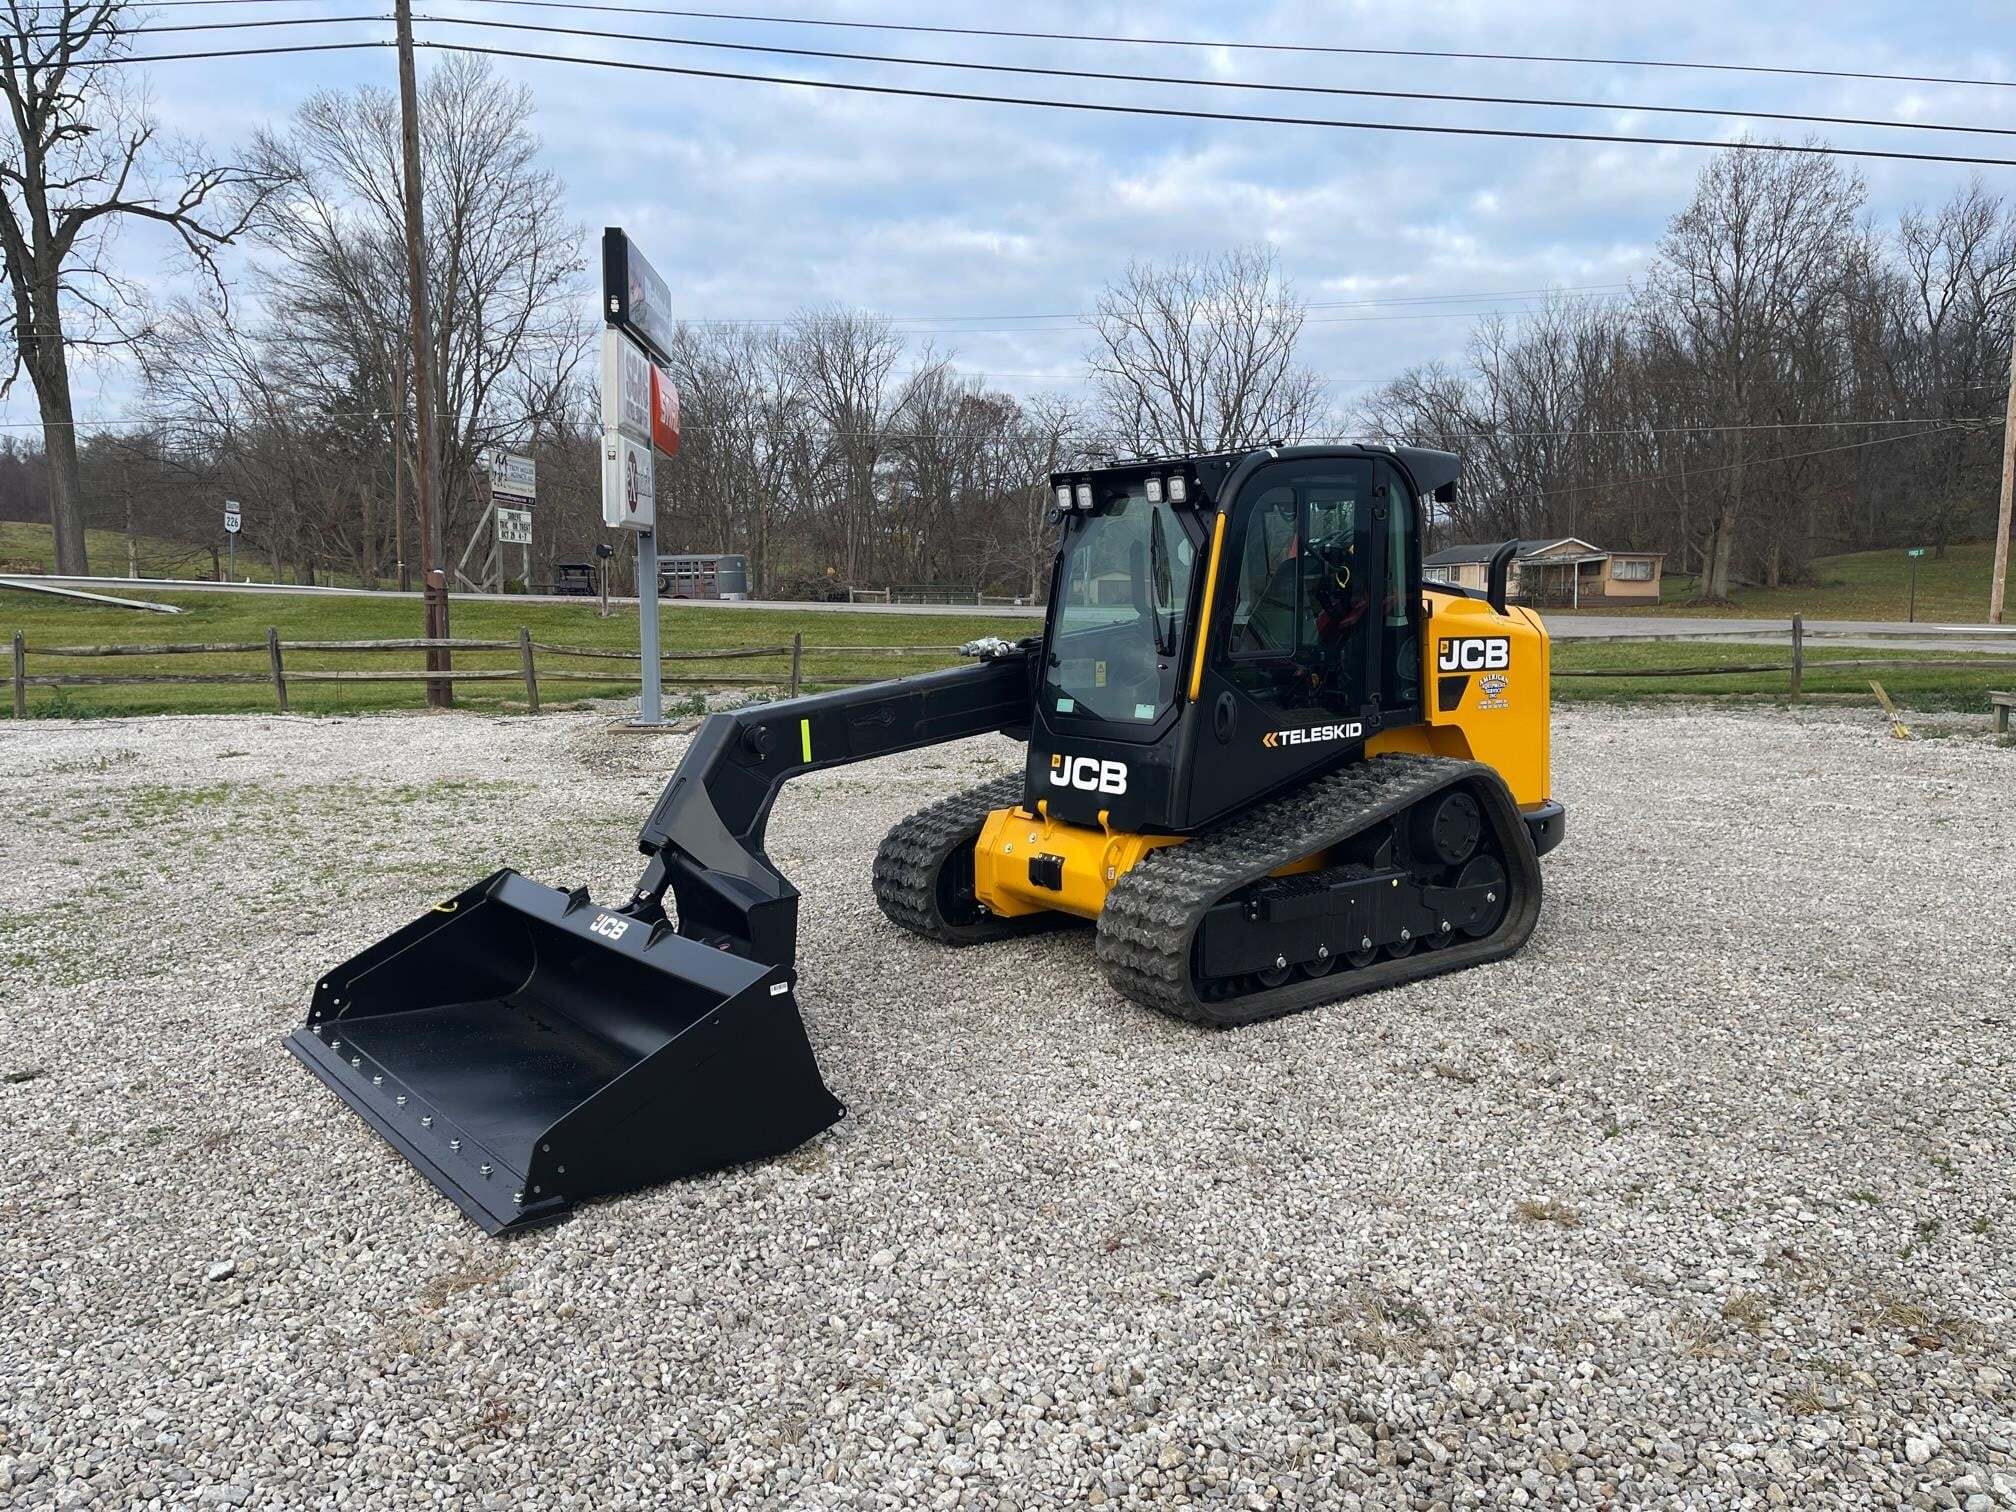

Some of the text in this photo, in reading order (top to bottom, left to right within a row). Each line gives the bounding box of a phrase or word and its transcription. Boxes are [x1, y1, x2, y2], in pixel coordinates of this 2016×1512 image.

[227, 516, 239, 528] 226
[1439, 638, 1509, 671] JCB
[1479, 674, 1509, 686] AMERICAN
[1278, 722, 1362, 746] TELESKID
[1050, 754, 1128, 795] JCB
[589, 913, 629, 941] JCB
